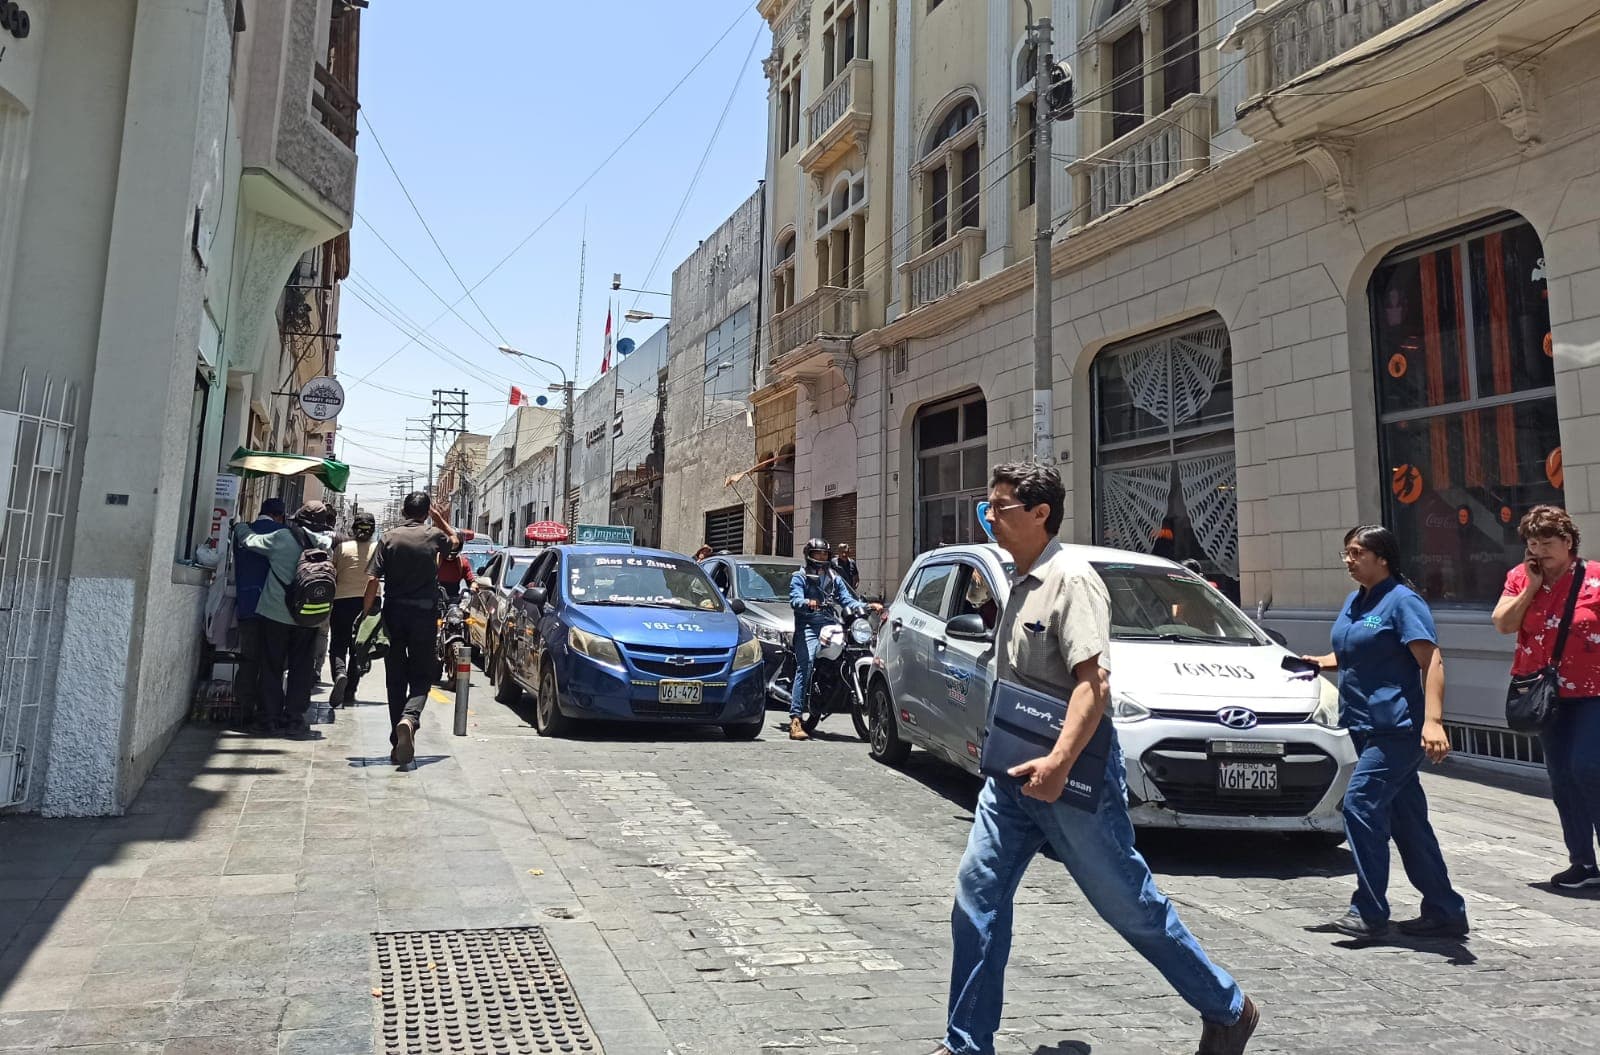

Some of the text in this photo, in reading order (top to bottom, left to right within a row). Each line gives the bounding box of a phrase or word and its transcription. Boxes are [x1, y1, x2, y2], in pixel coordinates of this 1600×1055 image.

[527, 526, 568, 536] PERU
[595, 558, 622, 566] Dios
[645, 560, 676, 570] Amor
[642, 622, 704, 633] V6I-472
[662, 686, 699, 699] V6I-472
[1219, 769, 1277, 789] V6M-203
[1069, 779, 1092, 793] esan
